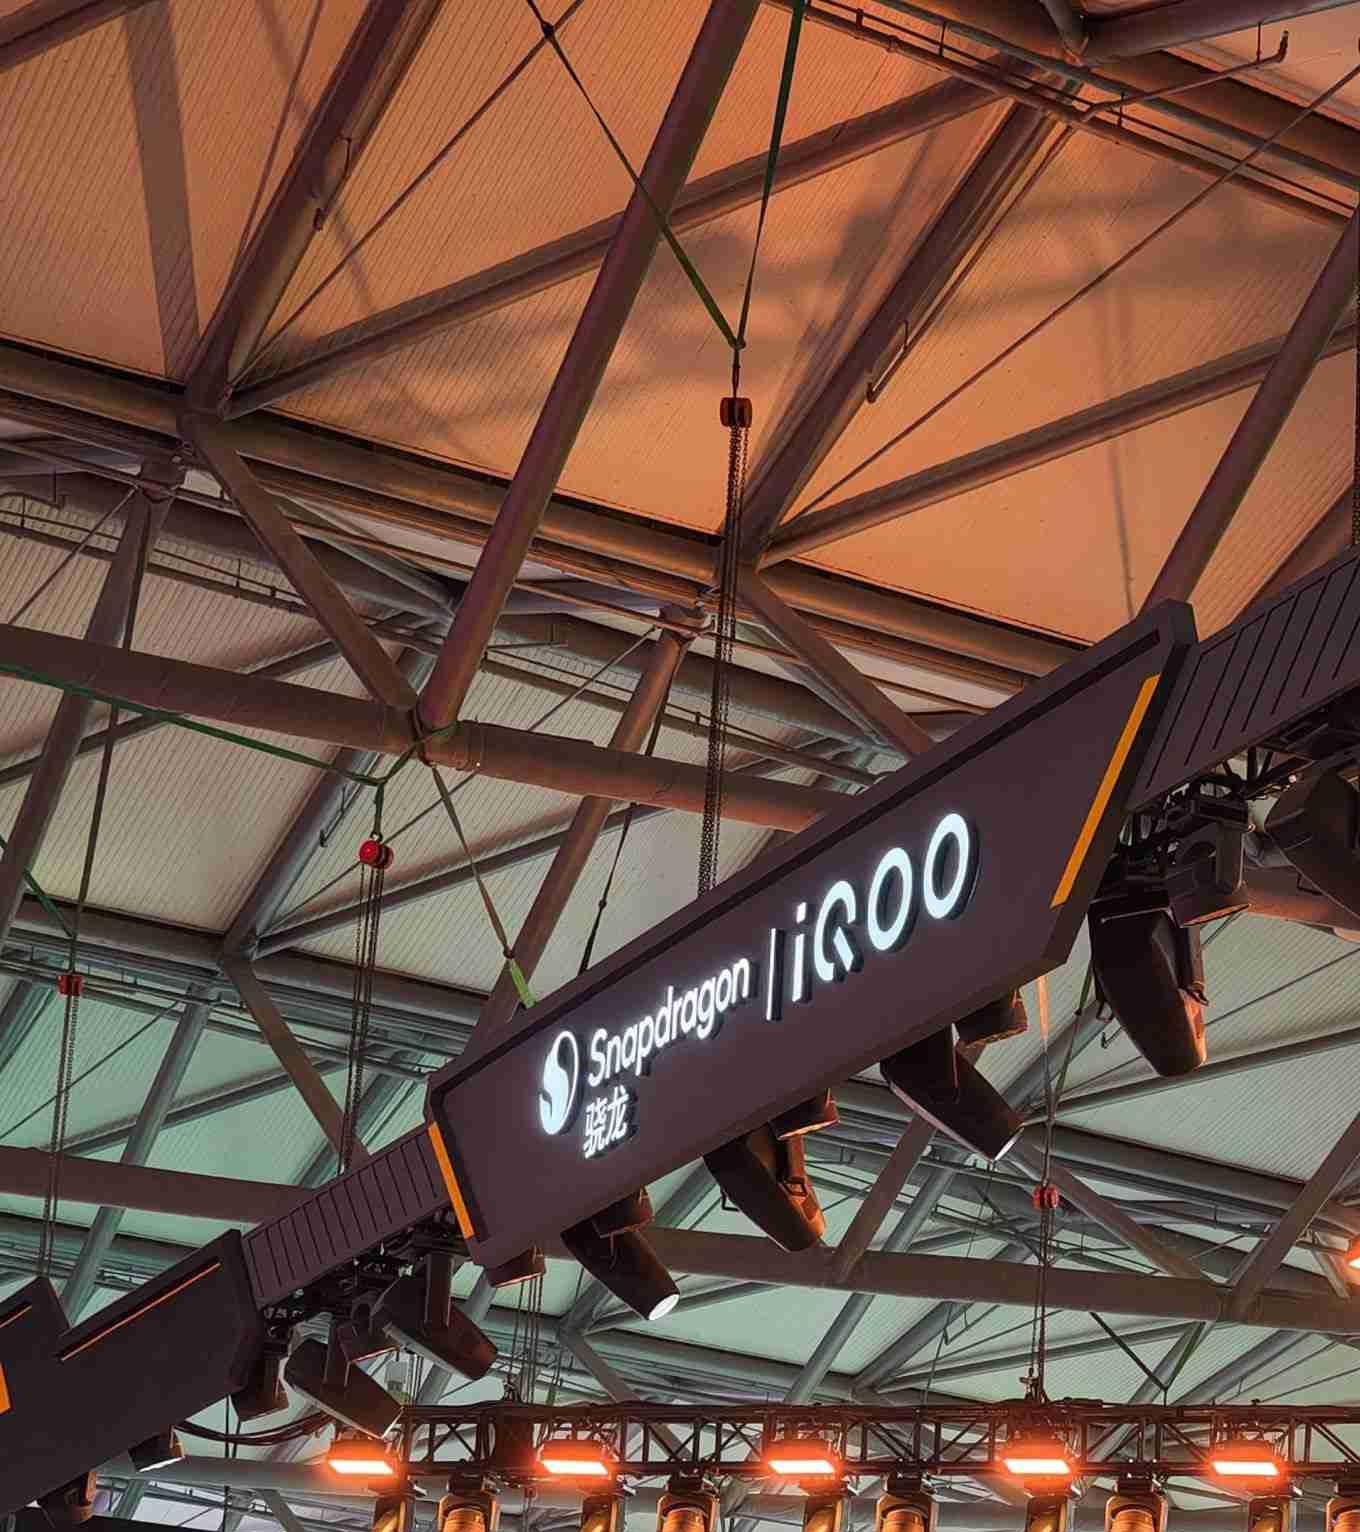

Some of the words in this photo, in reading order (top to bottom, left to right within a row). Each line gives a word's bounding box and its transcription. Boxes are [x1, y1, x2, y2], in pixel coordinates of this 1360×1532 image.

[588, 958, 750, 1087] Snapdragon
[790, 812, 971, 1003] iQOO
[583, 1086, 631, 1160] 骁龙
